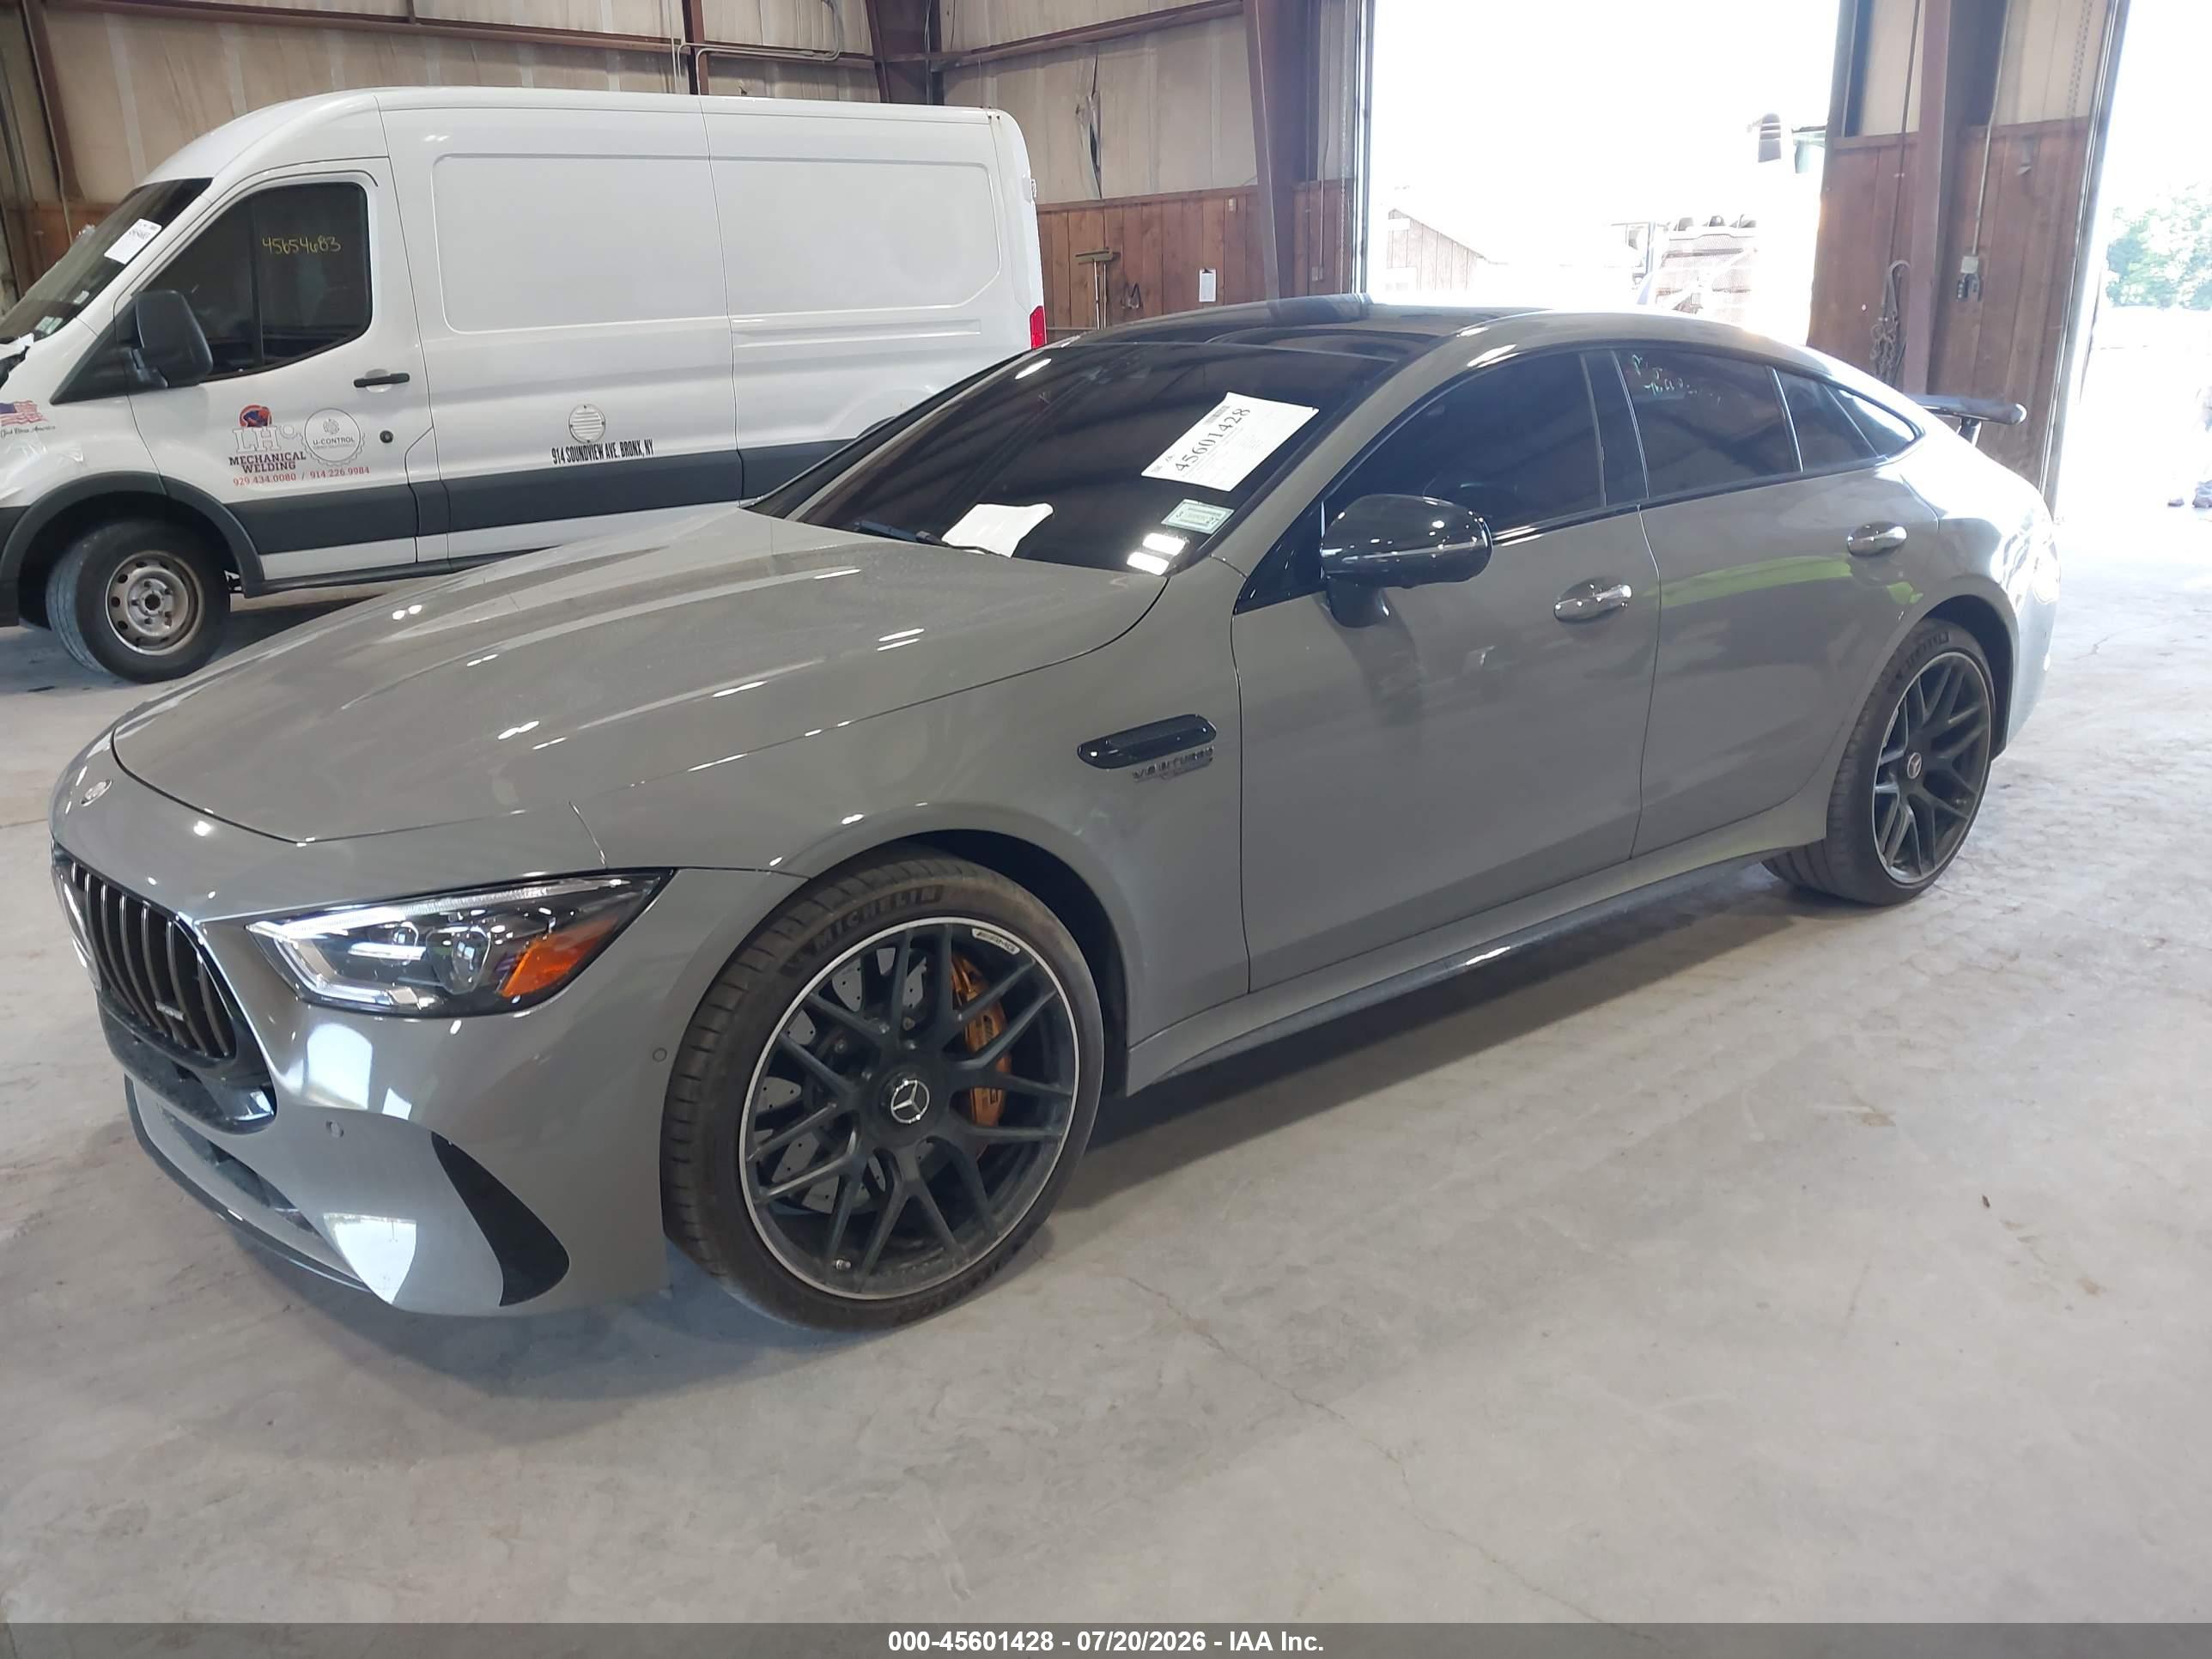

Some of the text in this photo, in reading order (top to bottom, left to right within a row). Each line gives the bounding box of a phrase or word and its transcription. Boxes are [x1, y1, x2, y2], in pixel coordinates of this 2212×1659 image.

[313, 437, 355, 446] U-CONTROL
[1175, 408, 1250, 471] 45601428
[229, 451, 307, 465] MECHANICAL
[551, 447, 566, 465] 914
[566, 444, 605, 463] SOUNDVIEW
[644, 439, 654, 455] NY
[242, 461, 296, 473] WELDING
